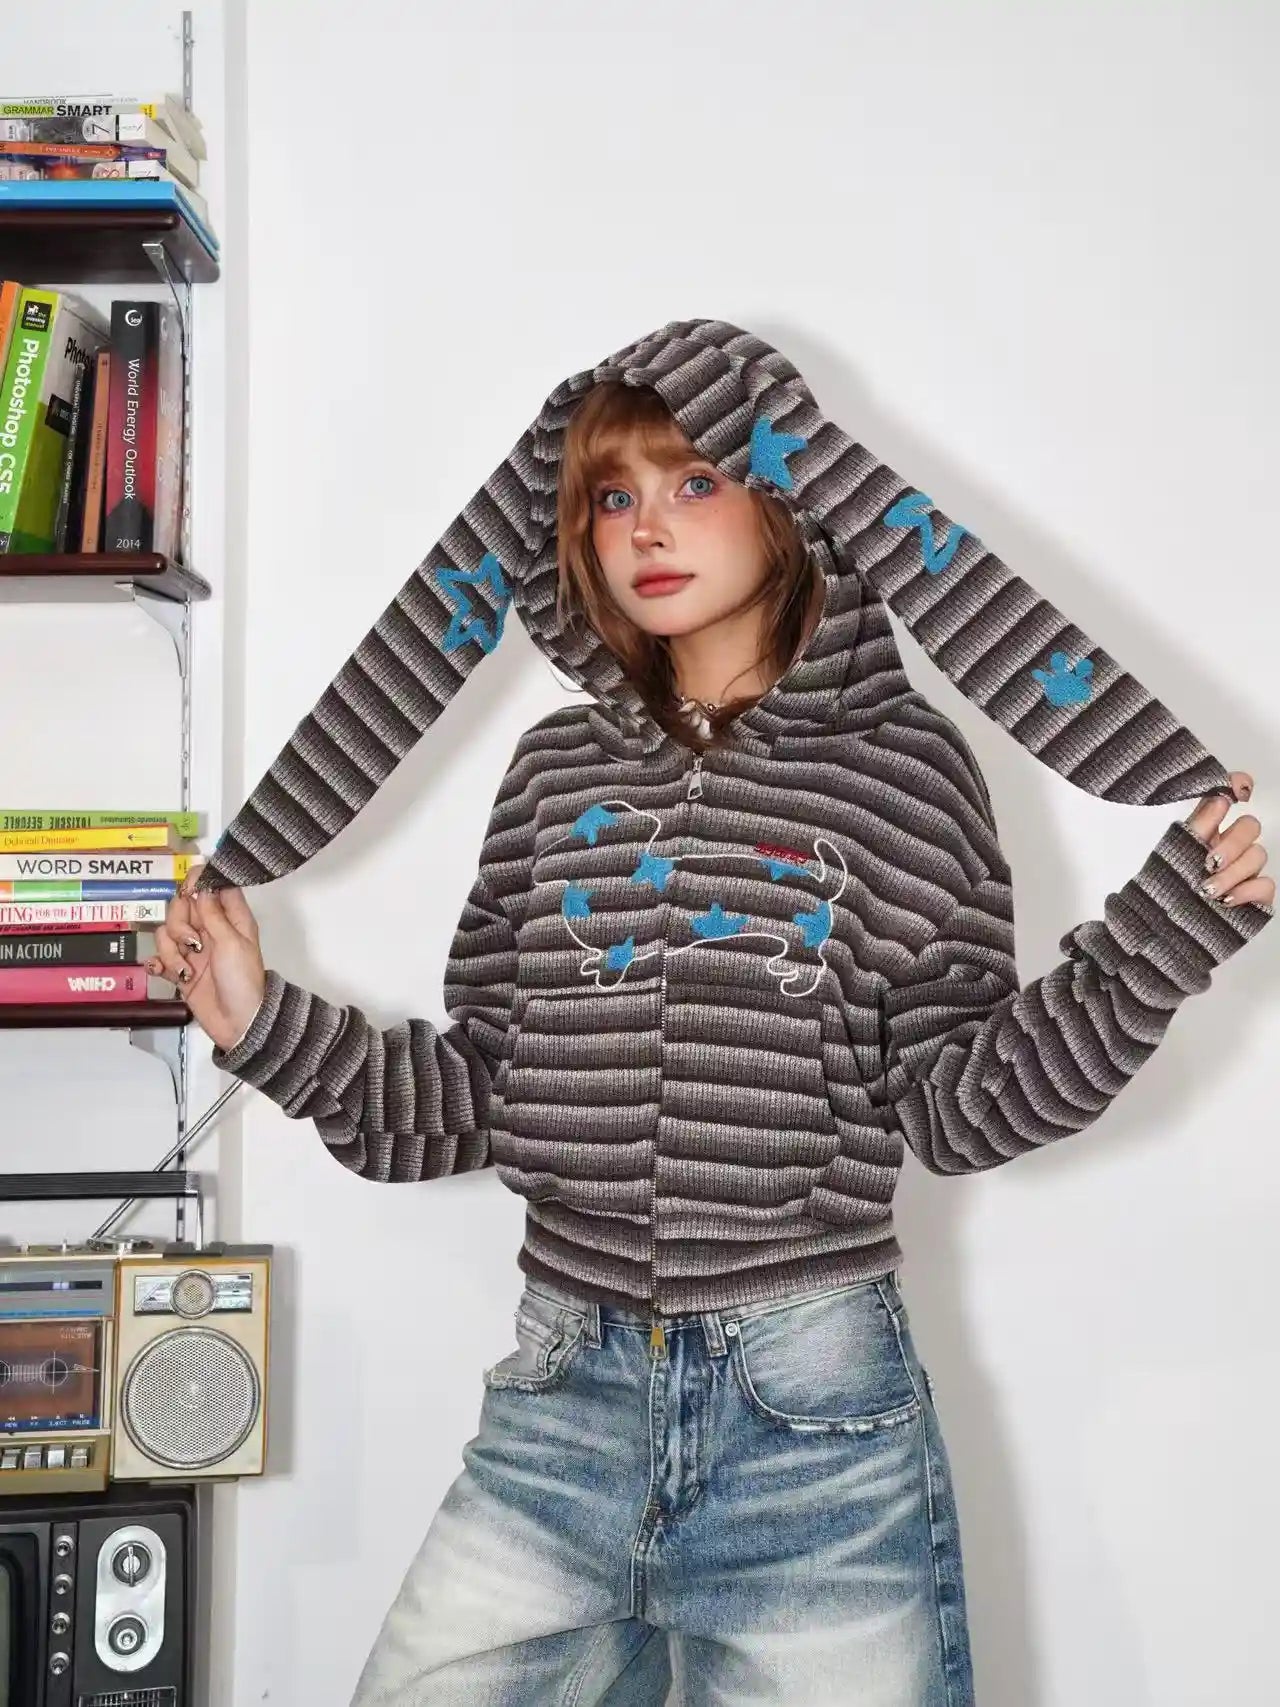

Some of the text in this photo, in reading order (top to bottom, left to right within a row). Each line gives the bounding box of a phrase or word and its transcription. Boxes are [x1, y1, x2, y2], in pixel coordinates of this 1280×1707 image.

[3, 105, 112, 117] GRAMMAR SMART
[0, 338, 40, 448] Photoshop
[122, 358, 140, 500] World Energy Outlook
[116, 538, 141, 549] 2014
[17, 860, 82, 875] WORD
[88, 860, 154, 875] SMART
[0, 943, 63, 960] IN ACTION
